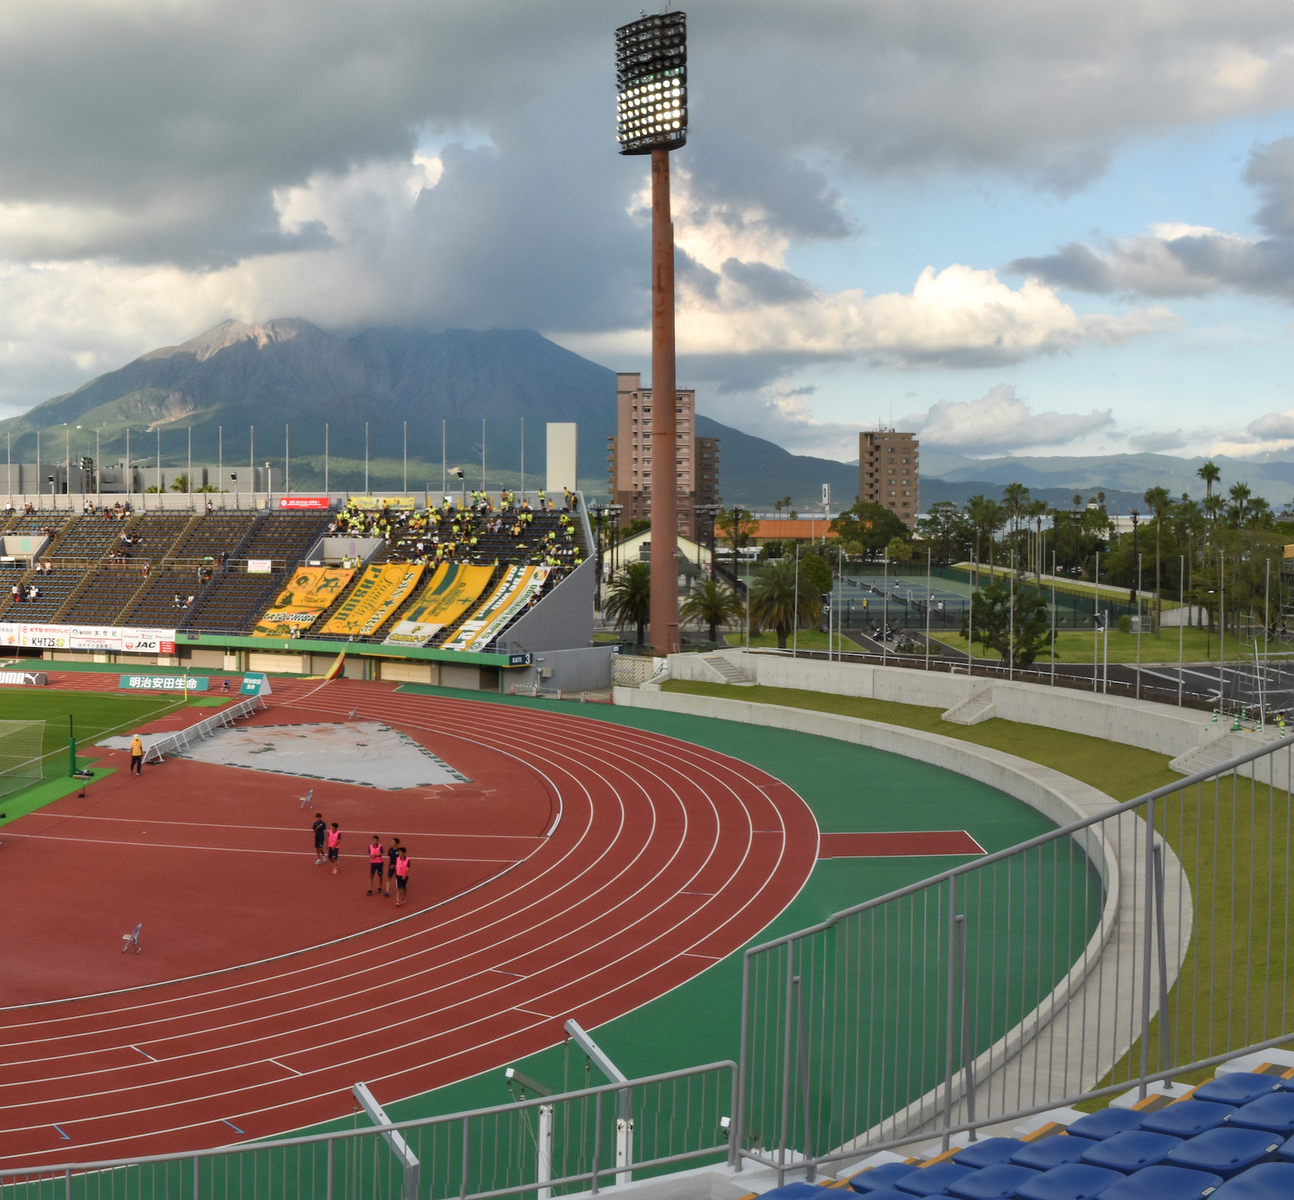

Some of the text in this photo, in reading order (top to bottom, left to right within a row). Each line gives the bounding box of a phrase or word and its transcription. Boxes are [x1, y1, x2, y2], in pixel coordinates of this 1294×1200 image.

[349, 542, 356, 556] 9
[525, 653, 531, 664] 3
[129, 676, 198, 690] 明治安田生命
